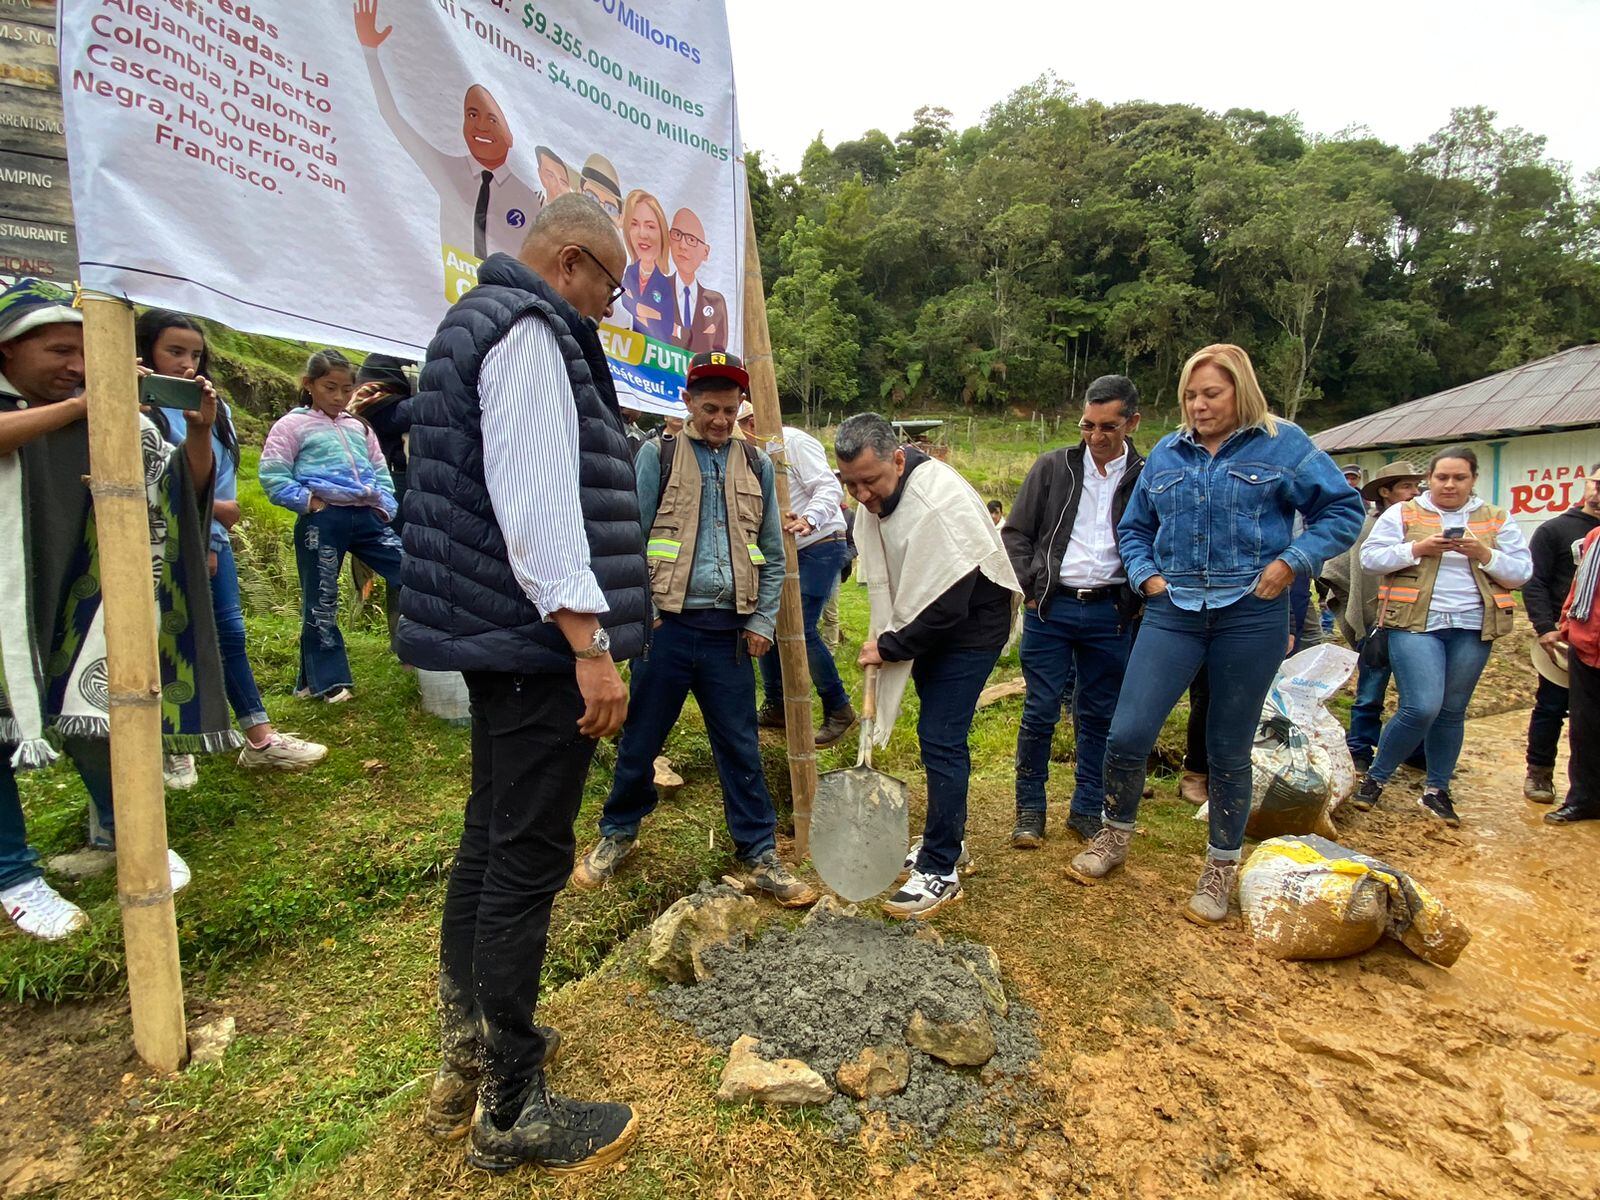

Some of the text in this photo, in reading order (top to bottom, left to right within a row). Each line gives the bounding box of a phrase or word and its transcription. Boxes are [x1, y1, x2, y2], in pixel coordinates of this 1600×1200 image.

[164, 0, 329, 87] eficiadas: La
[522, 2, 704, 117] $9.355.000 Millones
[617, 1, 701, 64] Millones
[87, 44, 338, 166] Cascada, Quebrada
[91, 15, 337, 144] Colombia, Palomar,
[250, 60, 332, 113] Puerto
[461, 8, 729, 161] Tolima: $4.000.000 Millones
[0, 113, 65, 135] RRENTISMO
[73, 70, 173, 121] Negra,
[179, 104, 244, 151] Hoyo
[249, 139, 302, 178] Frío,
[307, 162, 346, 193] San
[0, 168, 52, 188] AMPING
[155, 123, 283, 194] Francisco.
[0, 224, 68, 243] STAURANTE
[0, 255, 54, 275] IONES
[598, 329, 632, 359] EN
[1528, 465, 1585, 481] TAPA
